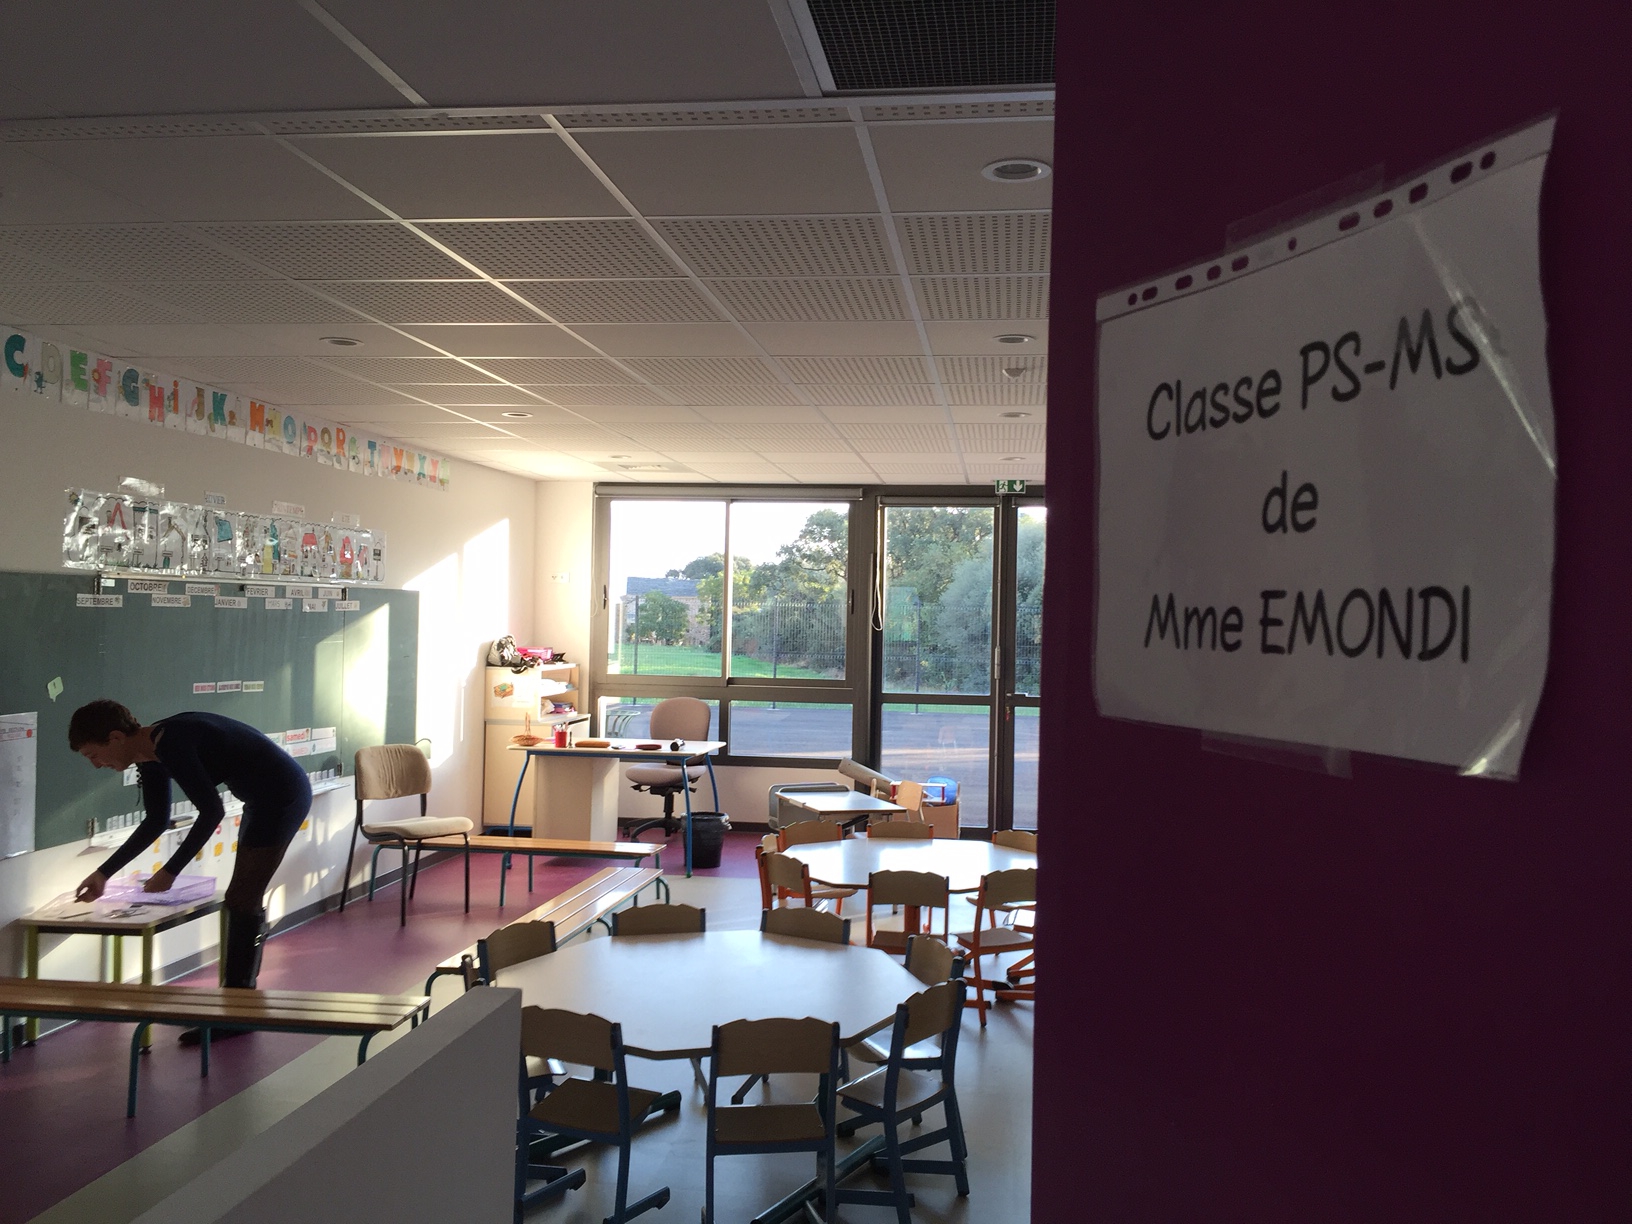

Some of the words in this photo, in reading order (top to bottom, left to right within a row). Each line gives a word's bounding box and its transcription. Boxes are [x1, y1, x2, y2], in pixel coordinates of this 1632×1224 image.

[1146, 368, 1283, 441] Classe
[1300, 304, 1481, 411] PS-MS
[4, 334, 26, 378] C
[70, 349, 88, 392] E
[96, 358, 113, 397] F
[122, 368, 139, 407] G
[149, 384, 164, 423] H
[212, 391, 228, 426] K
[249, 400, 266, 435] M
[335, 427, 347, 458] R
[1262, 469, 1319, 535] de
[77, 597, 114, 606] SEPTEMBRE
[129, 581, 162, 592] OCTOBRE
[152, 597, 182, 605] NOVEMBRE
[215, 599, 237, 607] JANVIER
[1144, 593, 1244, 653] Mme
[1260, 585, 1471, 662] EMONDI
